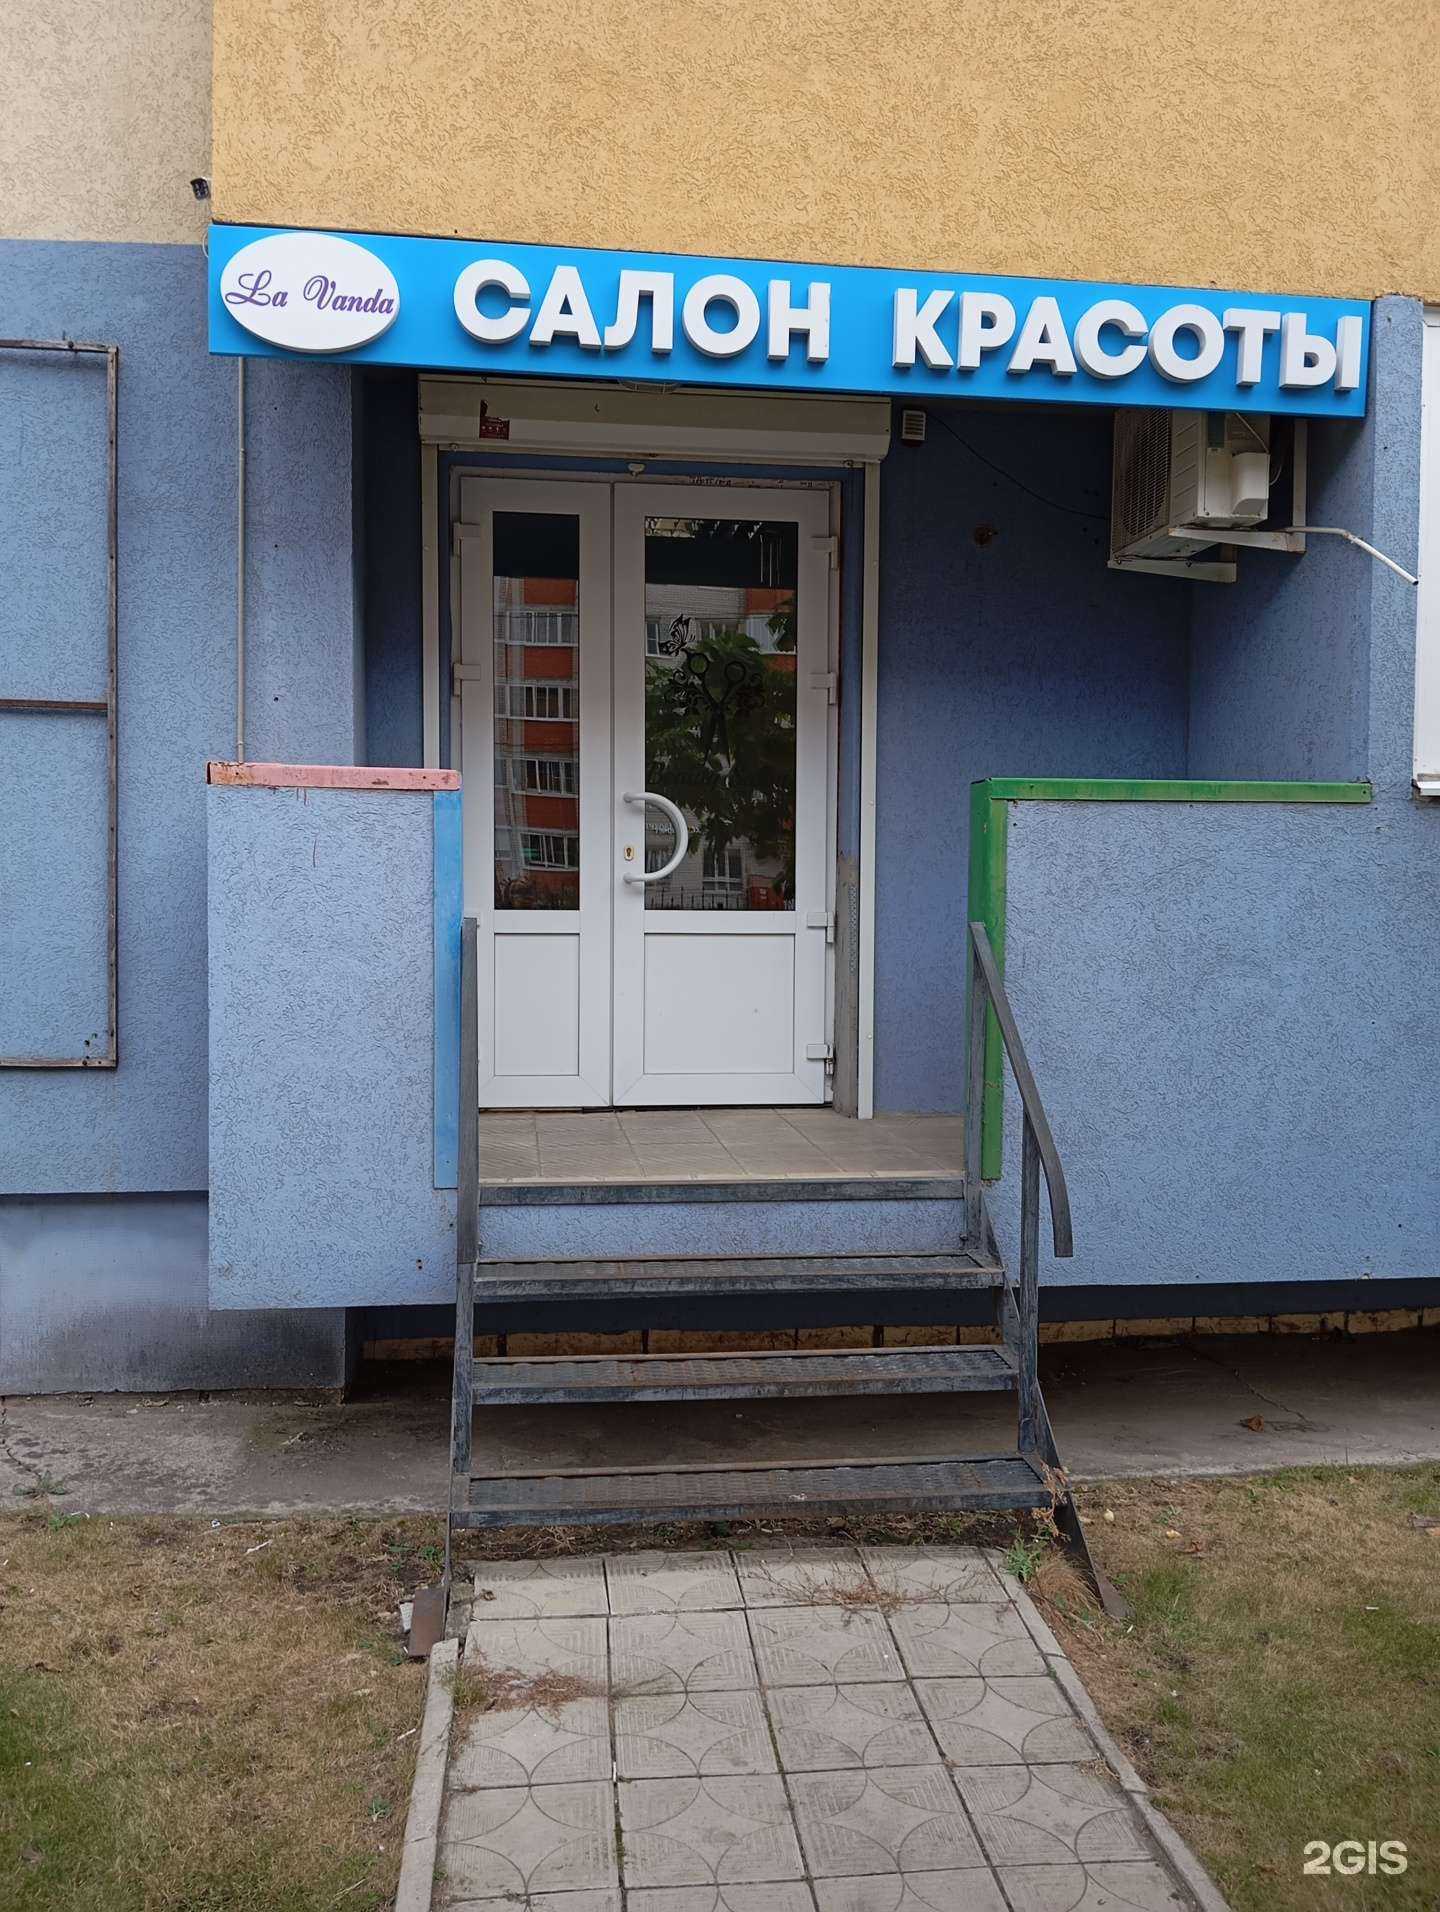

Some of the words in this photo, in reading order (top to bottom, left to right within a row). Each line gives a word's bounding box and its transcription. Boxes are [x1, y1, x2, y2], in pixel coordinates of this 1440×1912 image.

[225, 270, 288, 307] La
[303, 275, 395, 314] Vanda
[453, 258, 831, 364] САЛОН
[892, 288, 1362, 390] КРАСОТЫ
